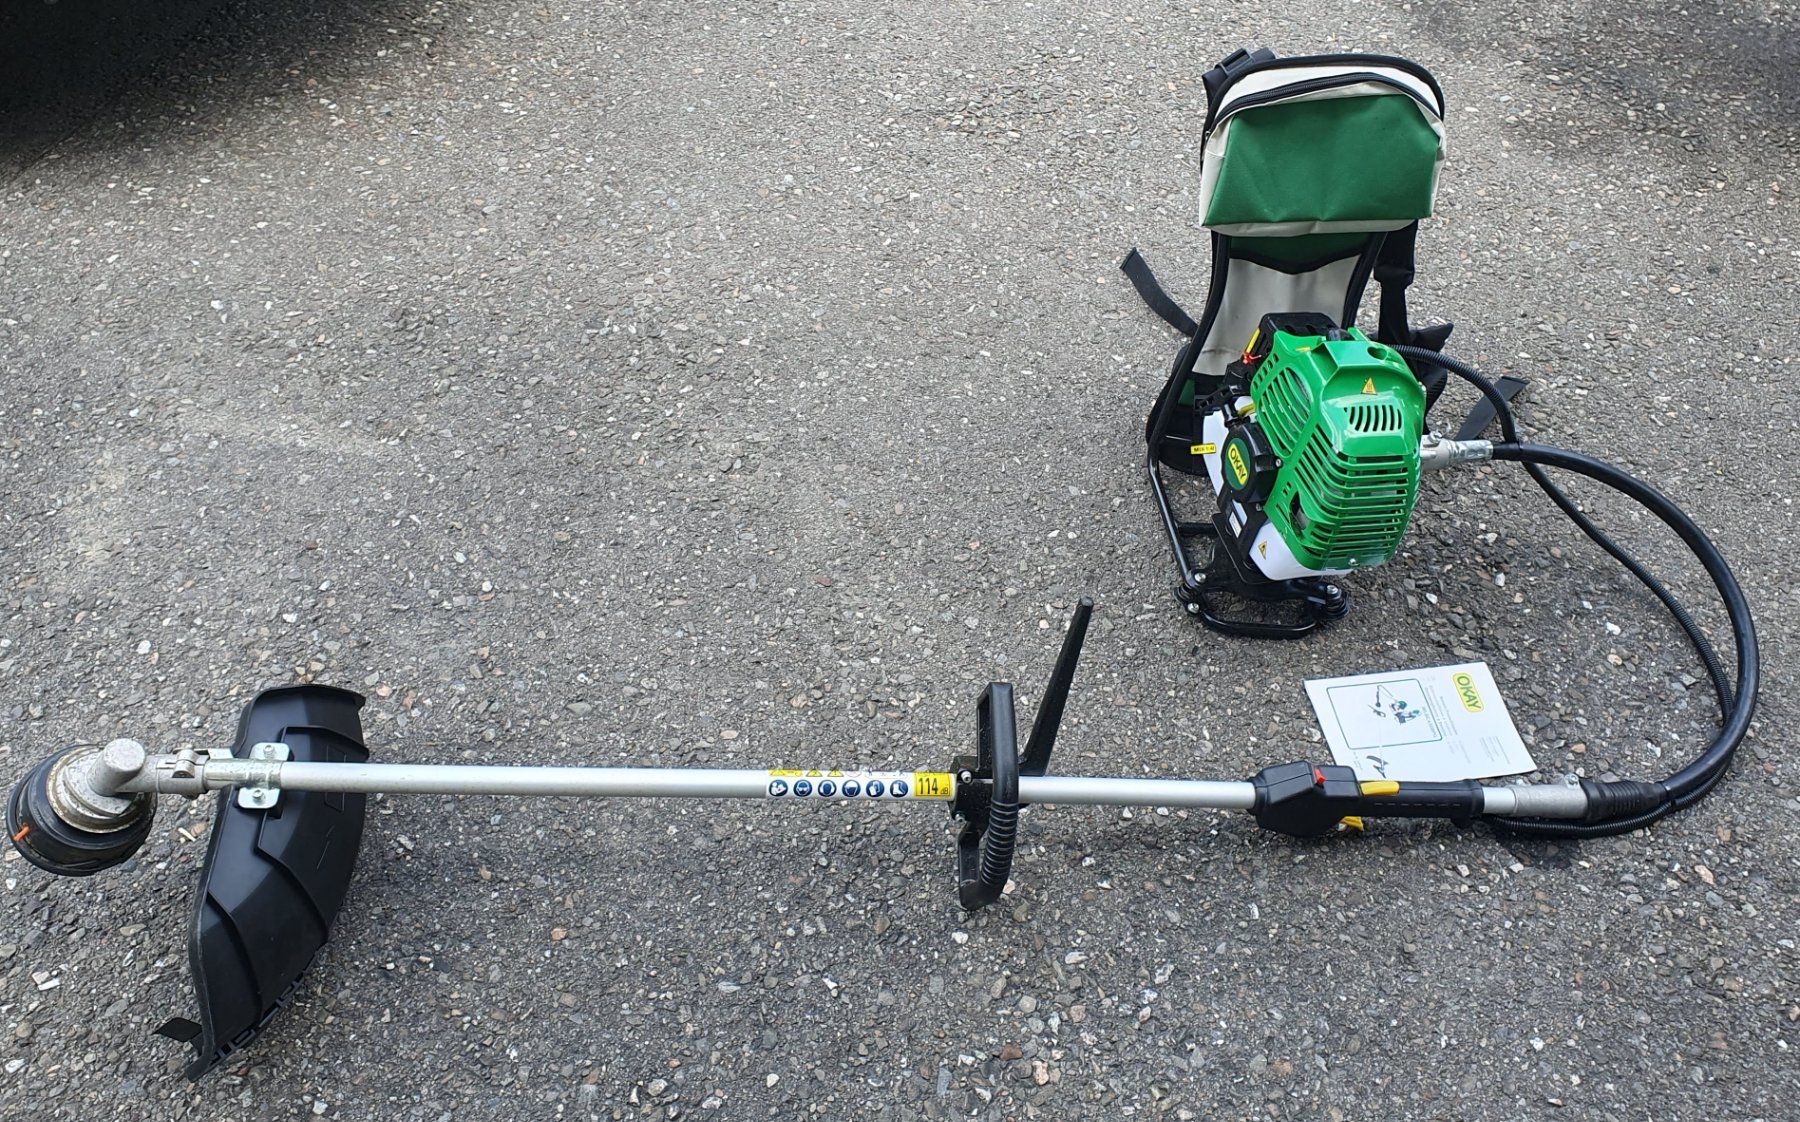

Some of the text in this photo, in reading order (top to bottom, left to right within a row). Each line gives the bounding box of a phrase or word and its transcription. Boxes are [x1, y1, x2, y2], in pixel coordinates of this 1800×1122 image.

[1230, 448, 1246, 479] OKAY
[1457, 675, 1482, 709] OKAY
[918, 777, 939, 795] 114
